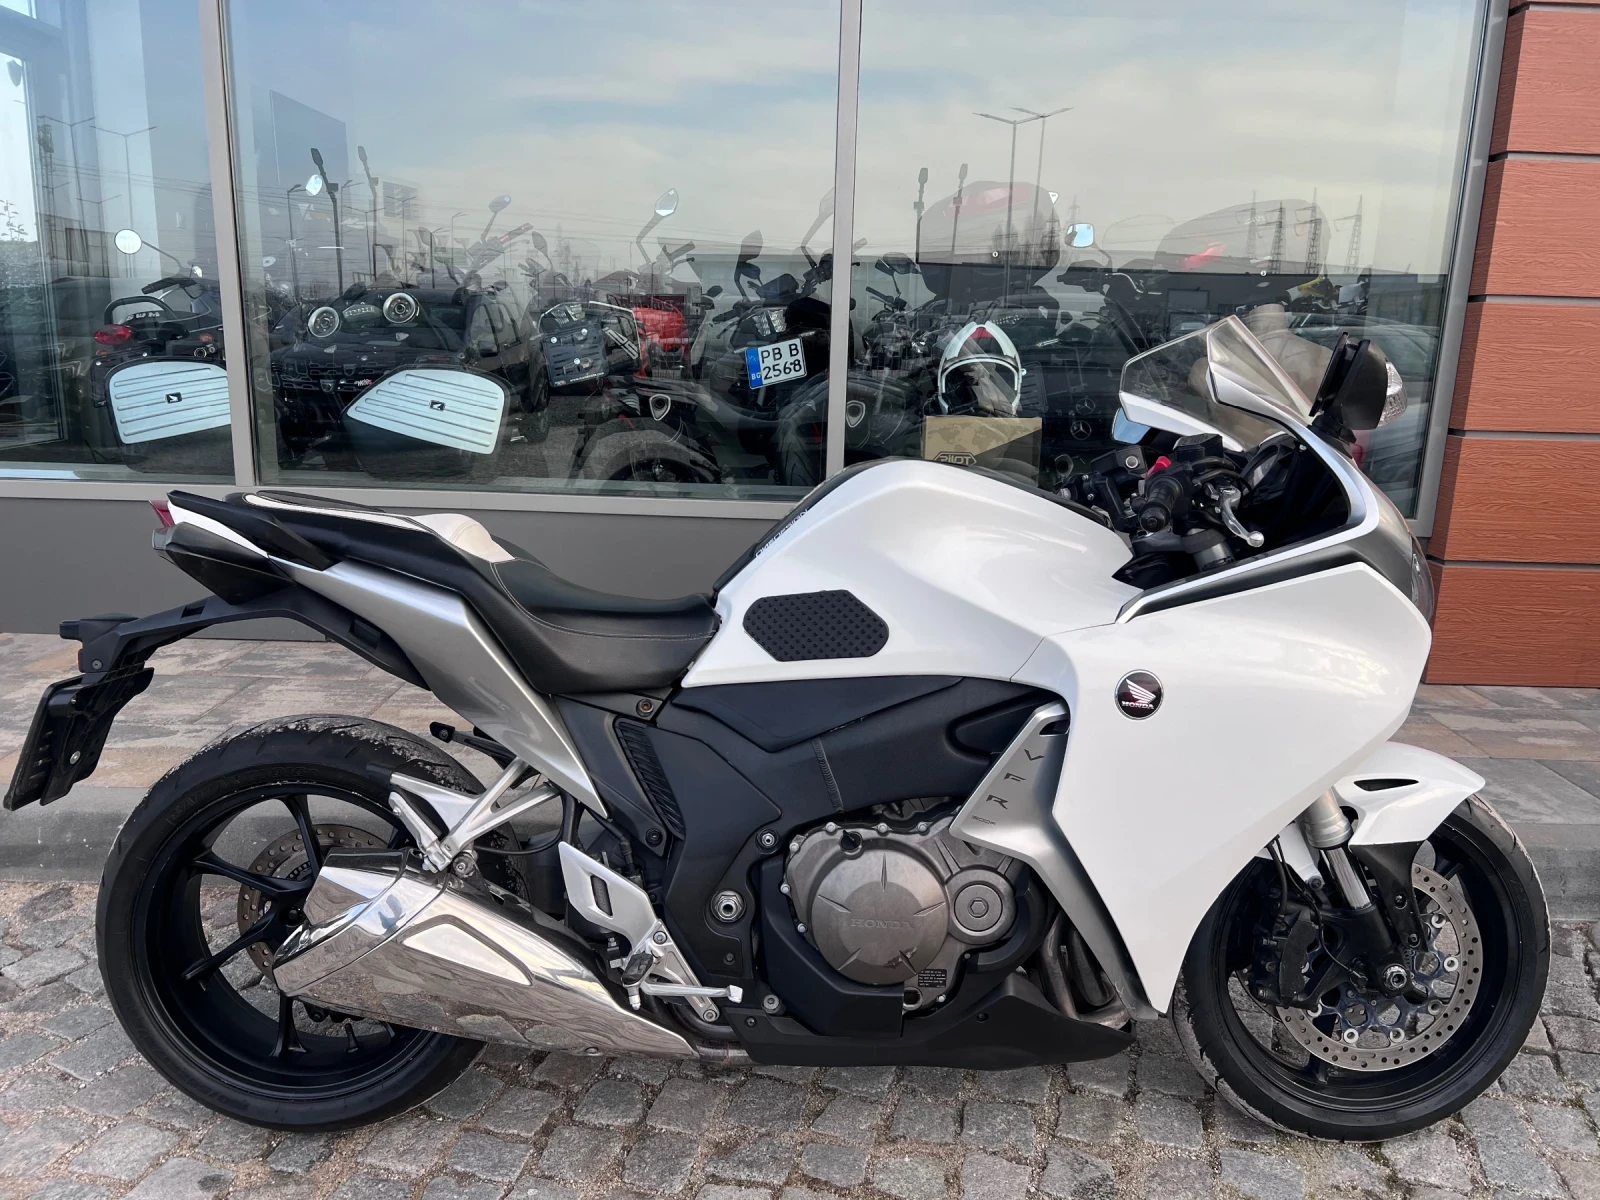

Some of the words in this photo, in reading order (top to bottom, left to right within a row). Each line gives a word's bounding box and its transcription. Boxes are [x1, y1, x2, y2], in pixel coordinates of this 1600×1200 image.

[760, 347, 783, 364] PB
[789, 343, 799, 357] B
[762, 358, 802, 380] 2568
[1121, 700, 1154, 710] HONDA
[985, 748, 1045, 810] VFR
[849, 917, 915, 929] HONDA
